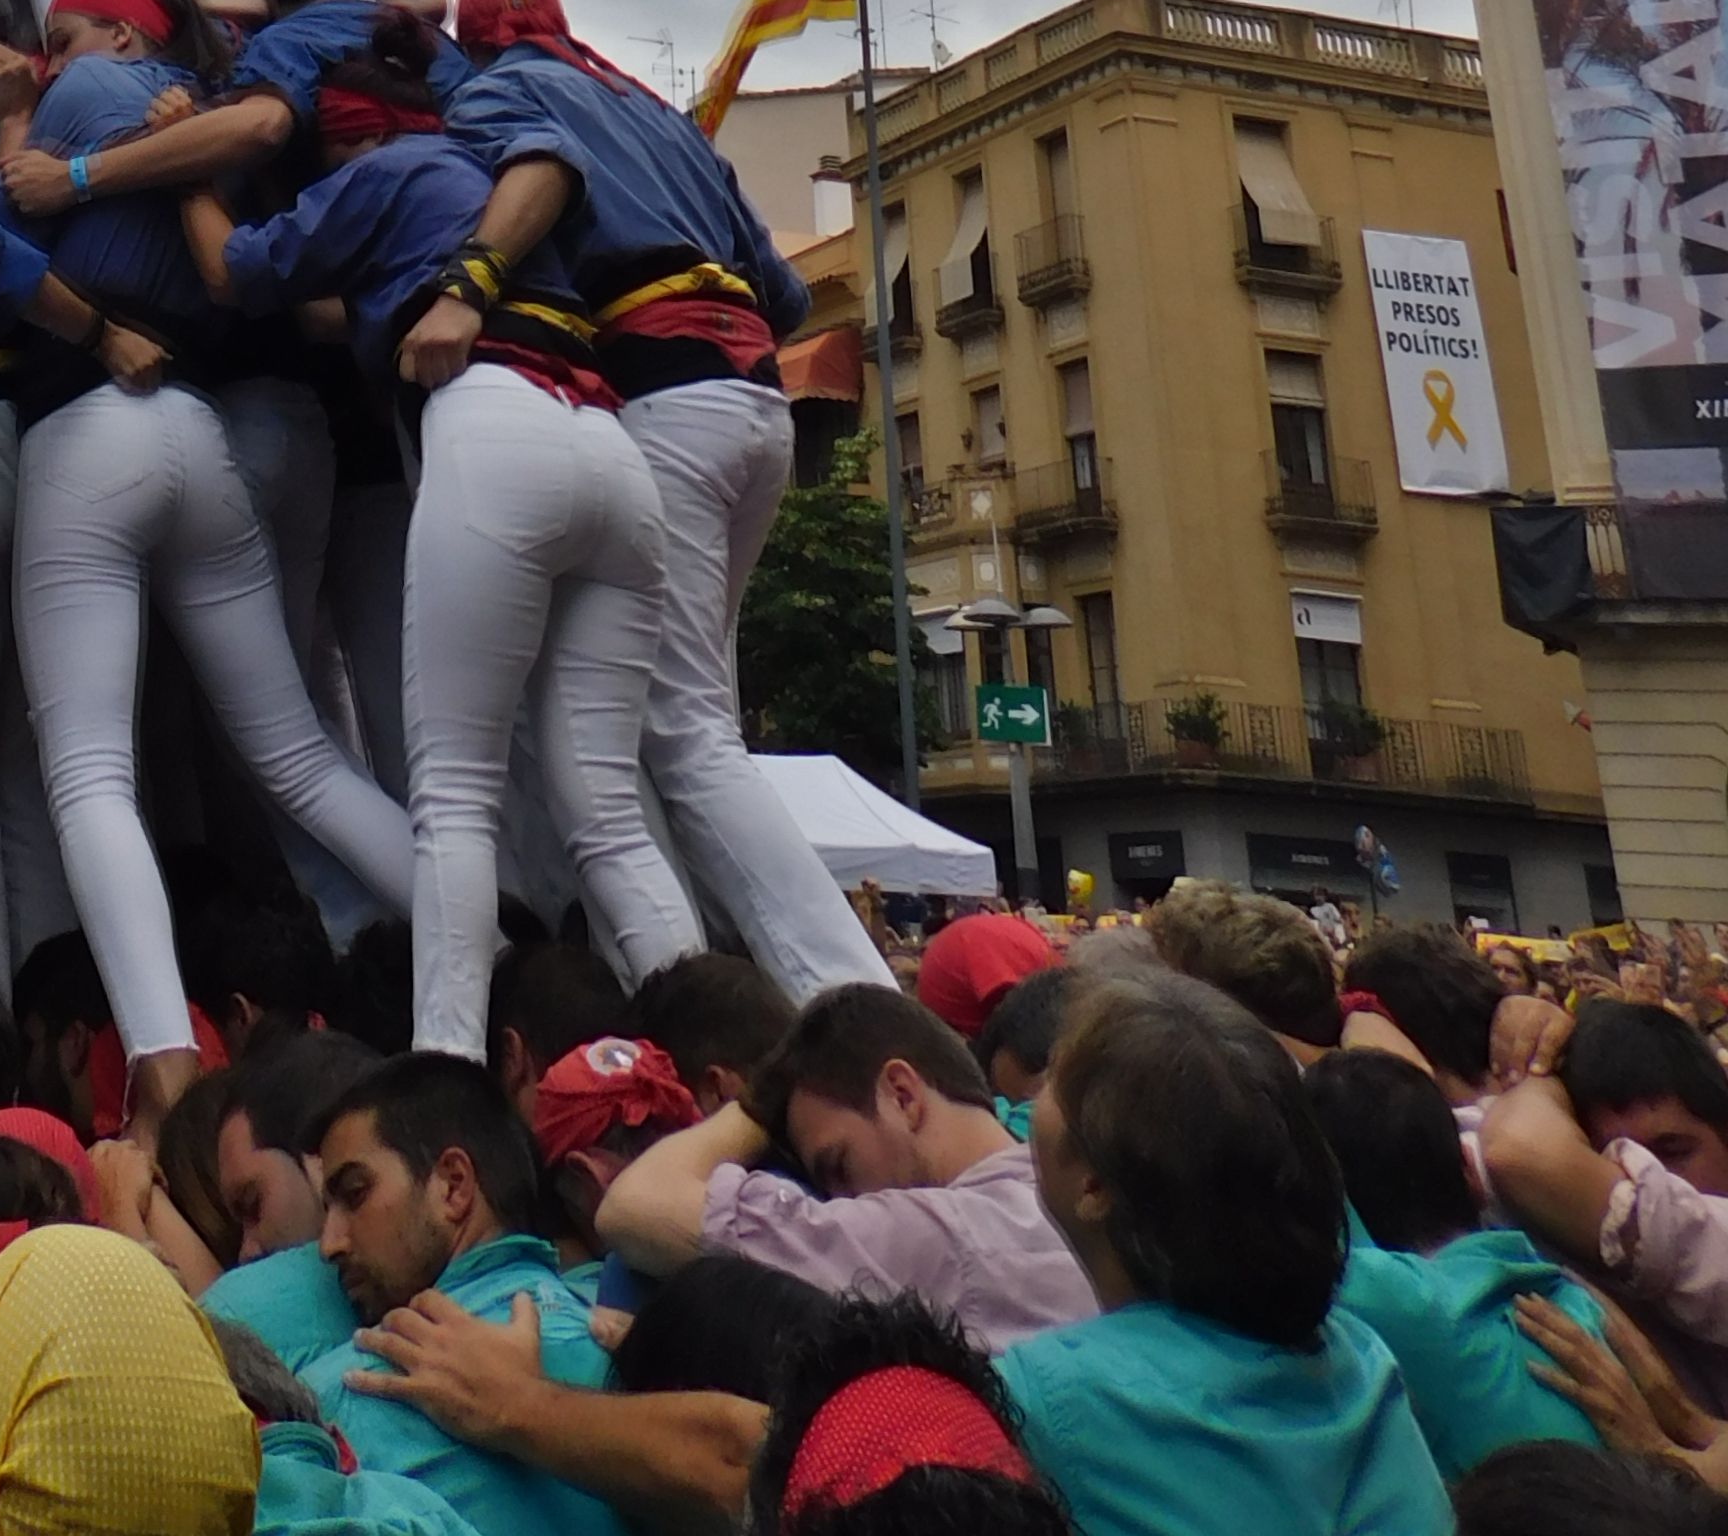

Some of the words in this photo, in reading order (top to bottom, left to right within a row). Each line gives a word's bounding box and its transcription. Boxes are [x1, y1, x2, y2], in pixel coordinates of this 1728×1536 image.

[1372, 267, 1470, 297] LLIBERTAT
[1391, 300, 1460, 327] PRESOS
[1385, 328, 1478, 359] POLÍTICS!
[1696, 399, 1728, 418] XI
